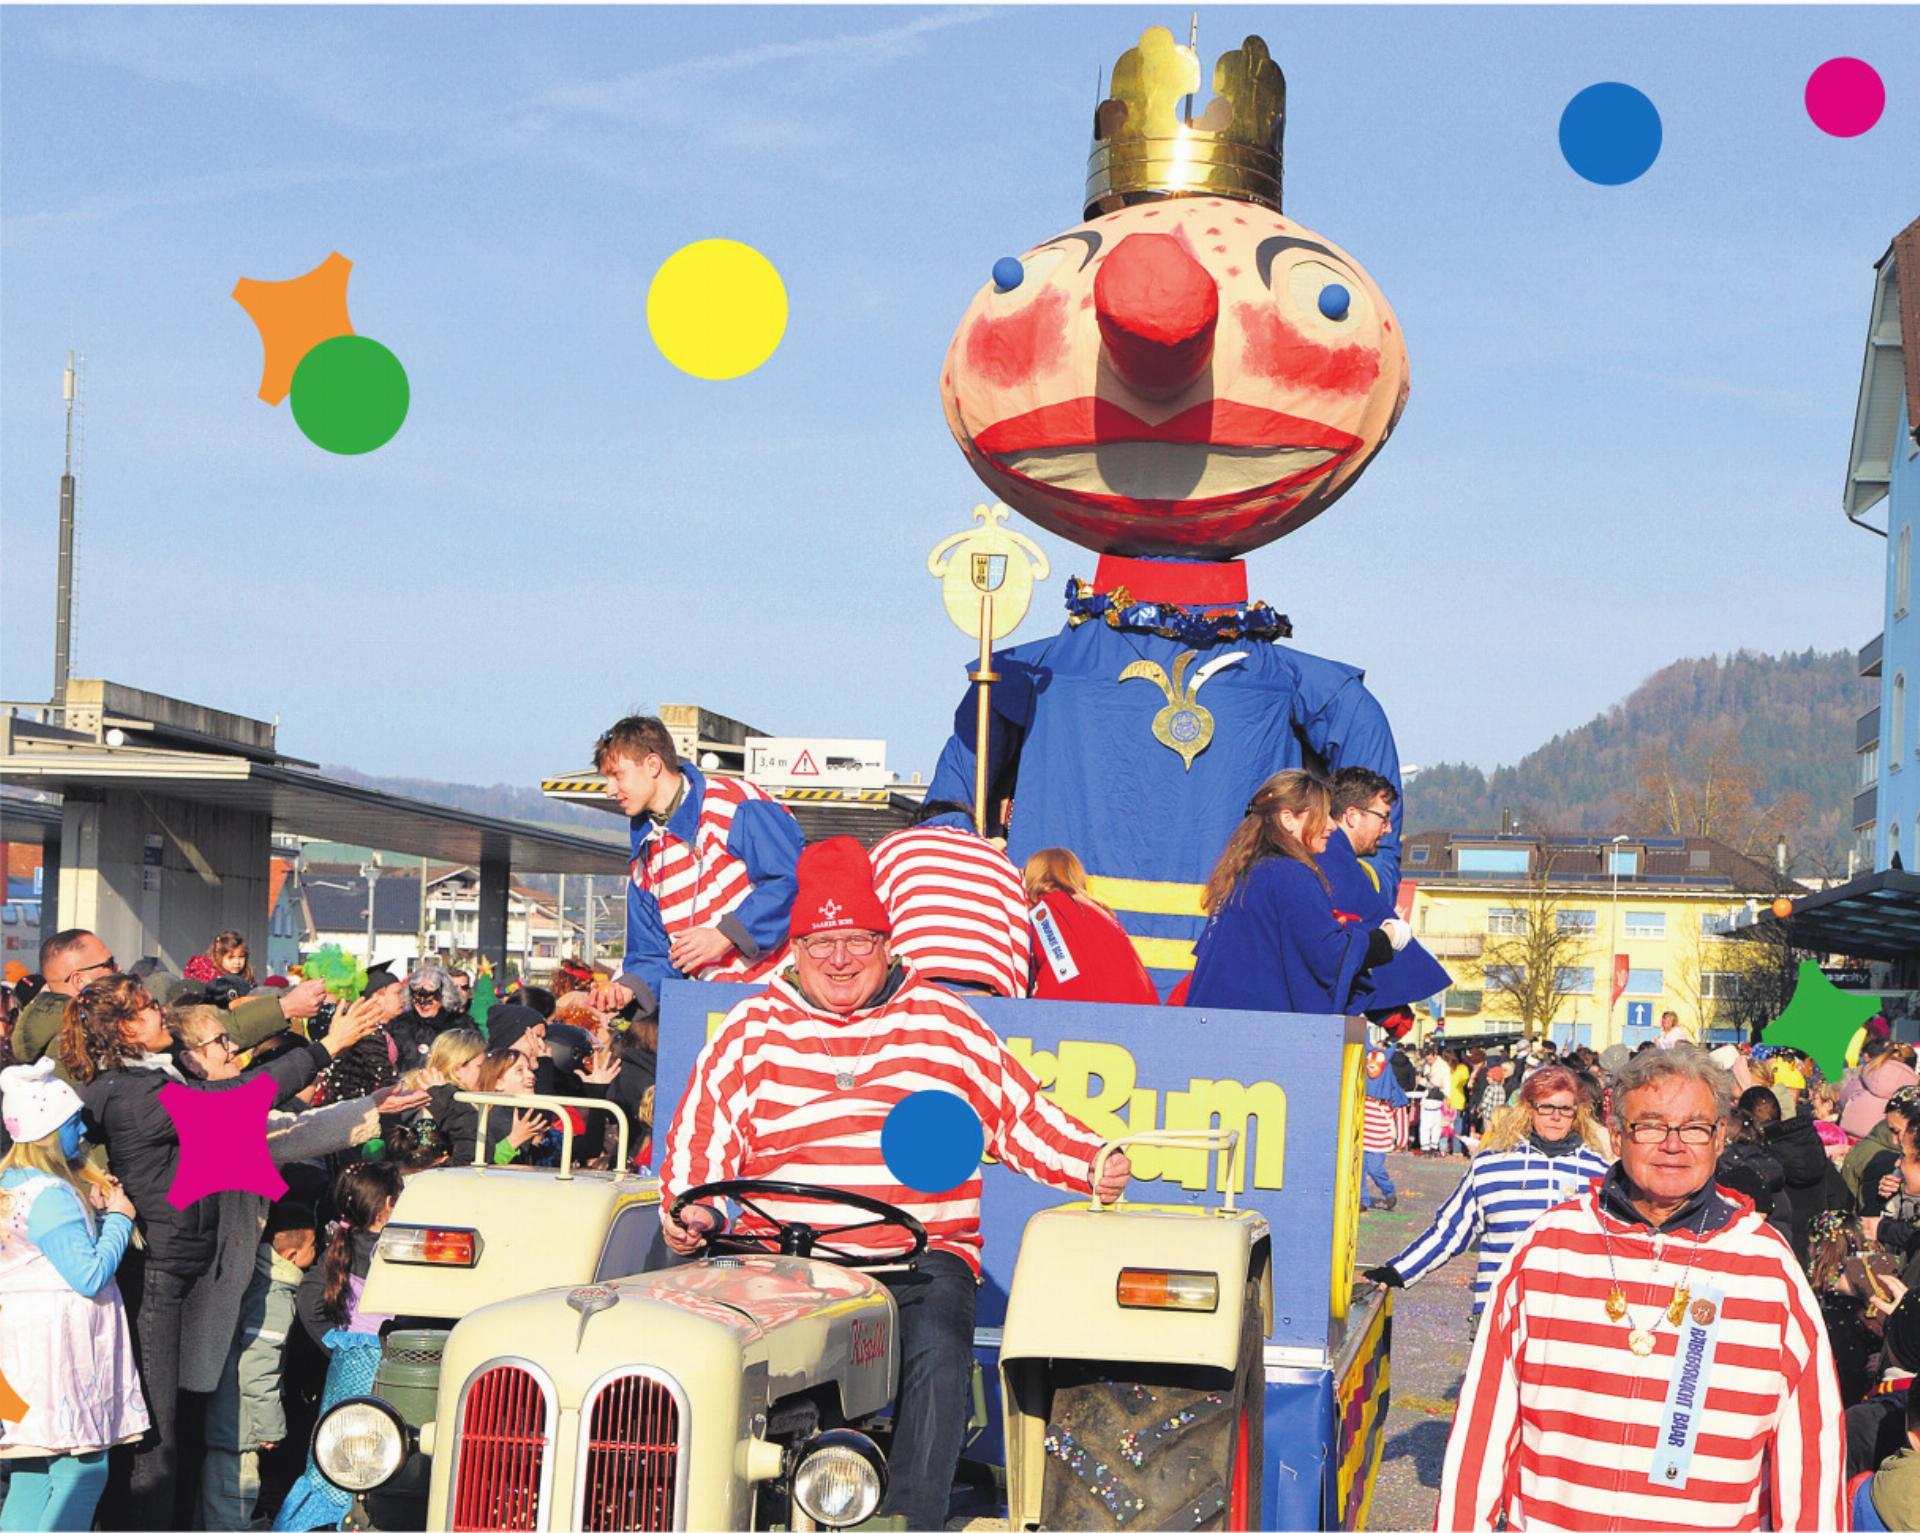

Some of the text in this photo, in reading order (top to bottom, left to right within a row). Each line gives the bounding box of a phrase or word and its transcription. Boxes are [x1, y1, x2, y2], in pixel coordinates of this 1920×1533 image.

[759, 757, 788, 768] 3,4 m
[1667, 1411, 1691, 1448] BAAR
